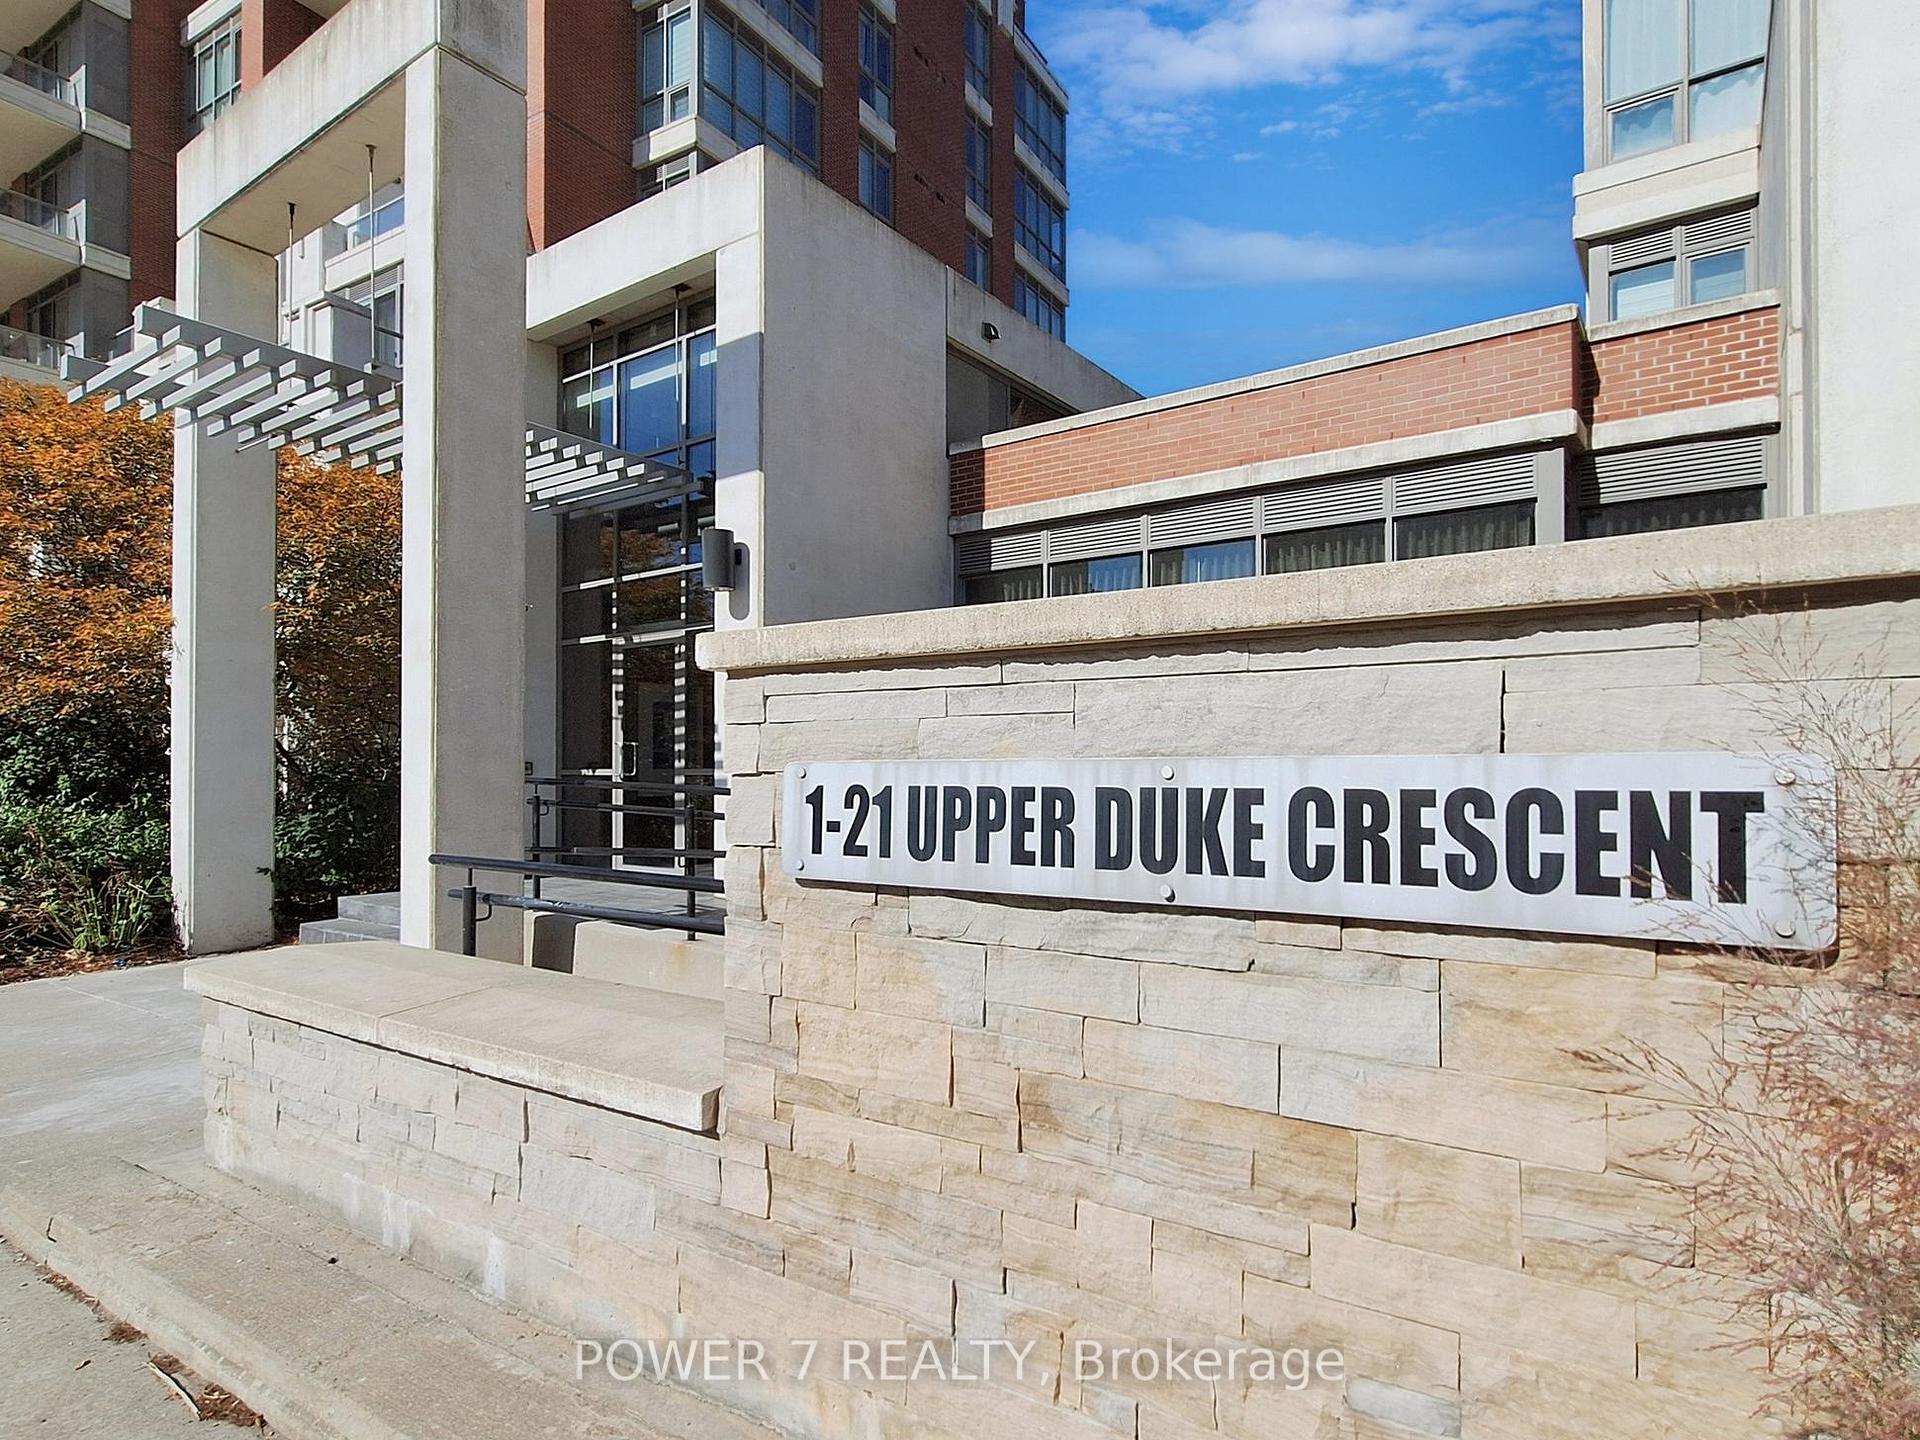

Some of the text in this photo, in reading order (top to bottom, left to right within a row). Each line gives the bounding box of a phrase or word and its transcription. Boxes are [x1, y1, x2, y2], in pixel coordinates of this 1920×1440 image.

[805, 784, 1766, 905] 1-21 UPPER DUKE CRESCENT
